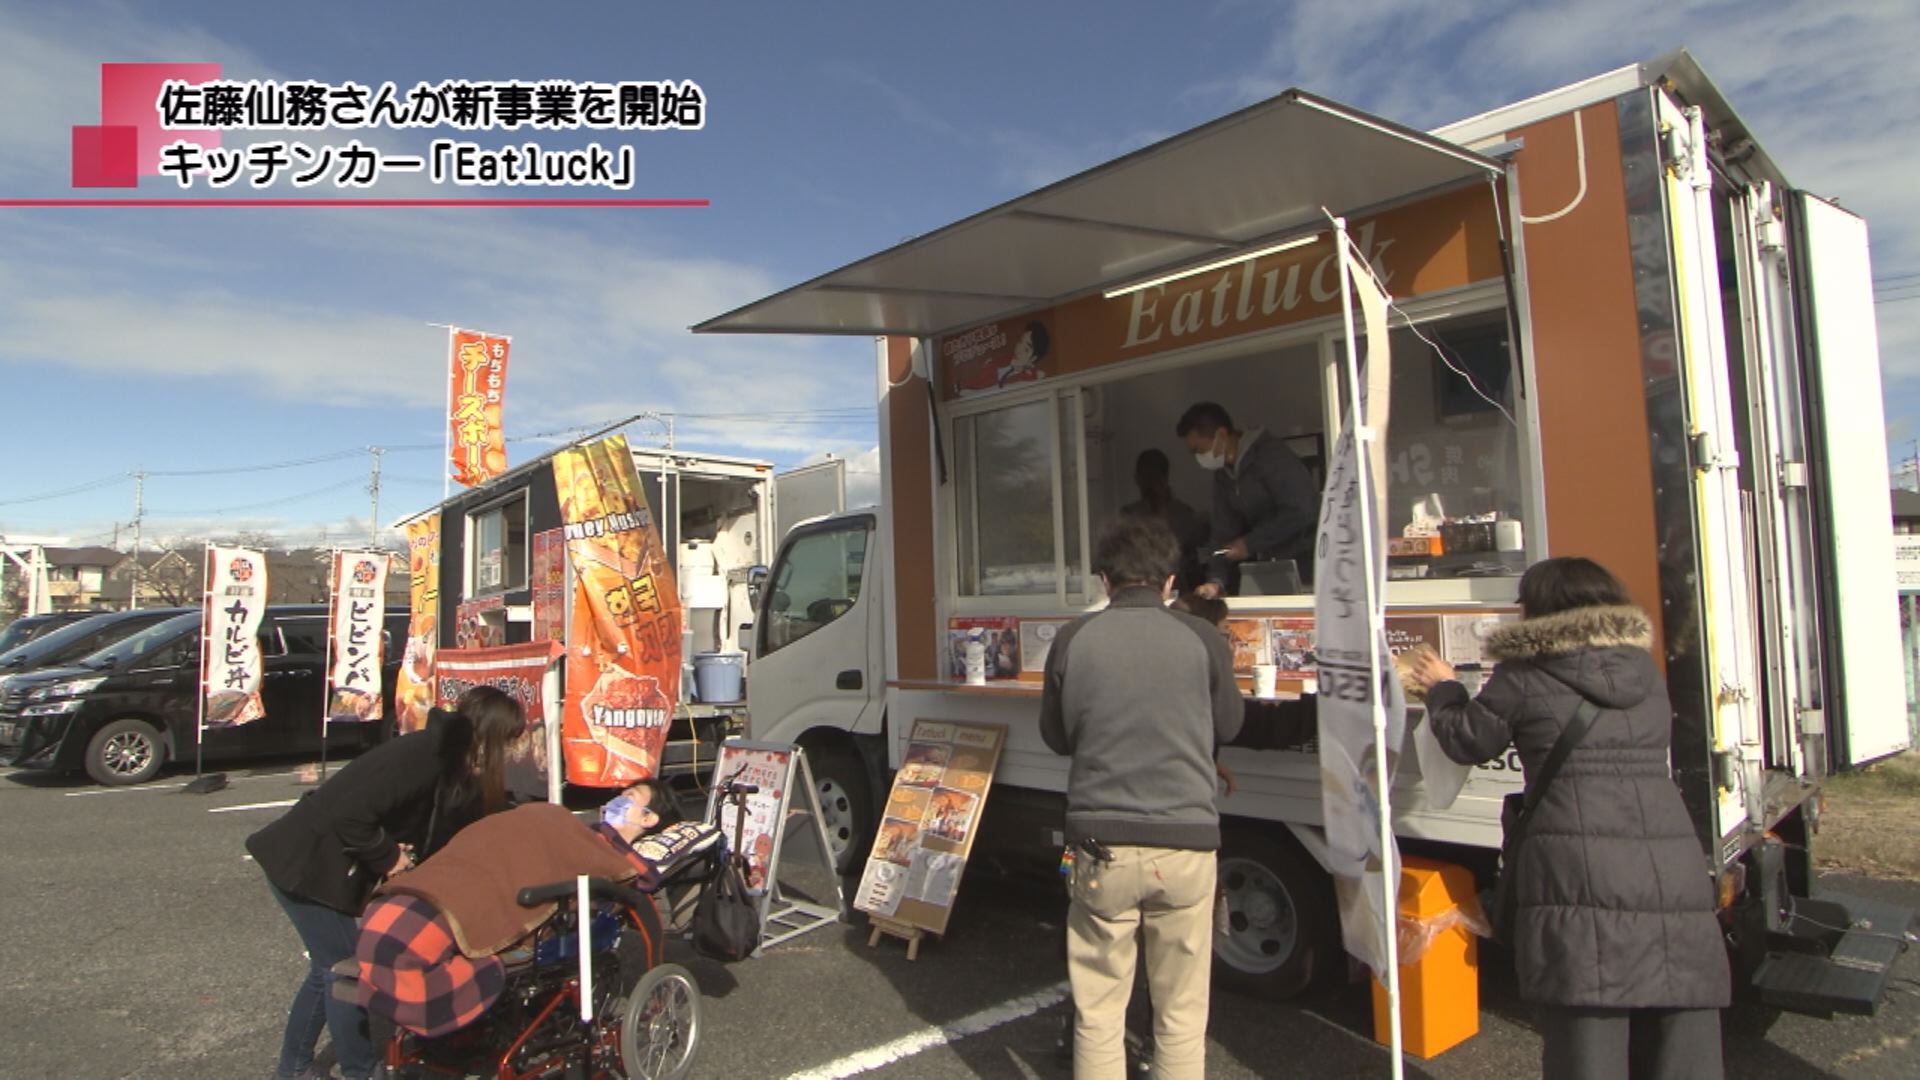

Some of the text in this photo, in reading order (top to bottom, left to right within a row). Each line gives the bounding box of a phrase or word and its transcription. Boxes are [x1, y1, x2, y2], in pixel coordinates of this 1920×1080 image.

[1119, 220, 1396, 349] Eatluck
[224, 599, 251, 690] カルビ丼
[345, 600, 374, 686] ビビンバ
